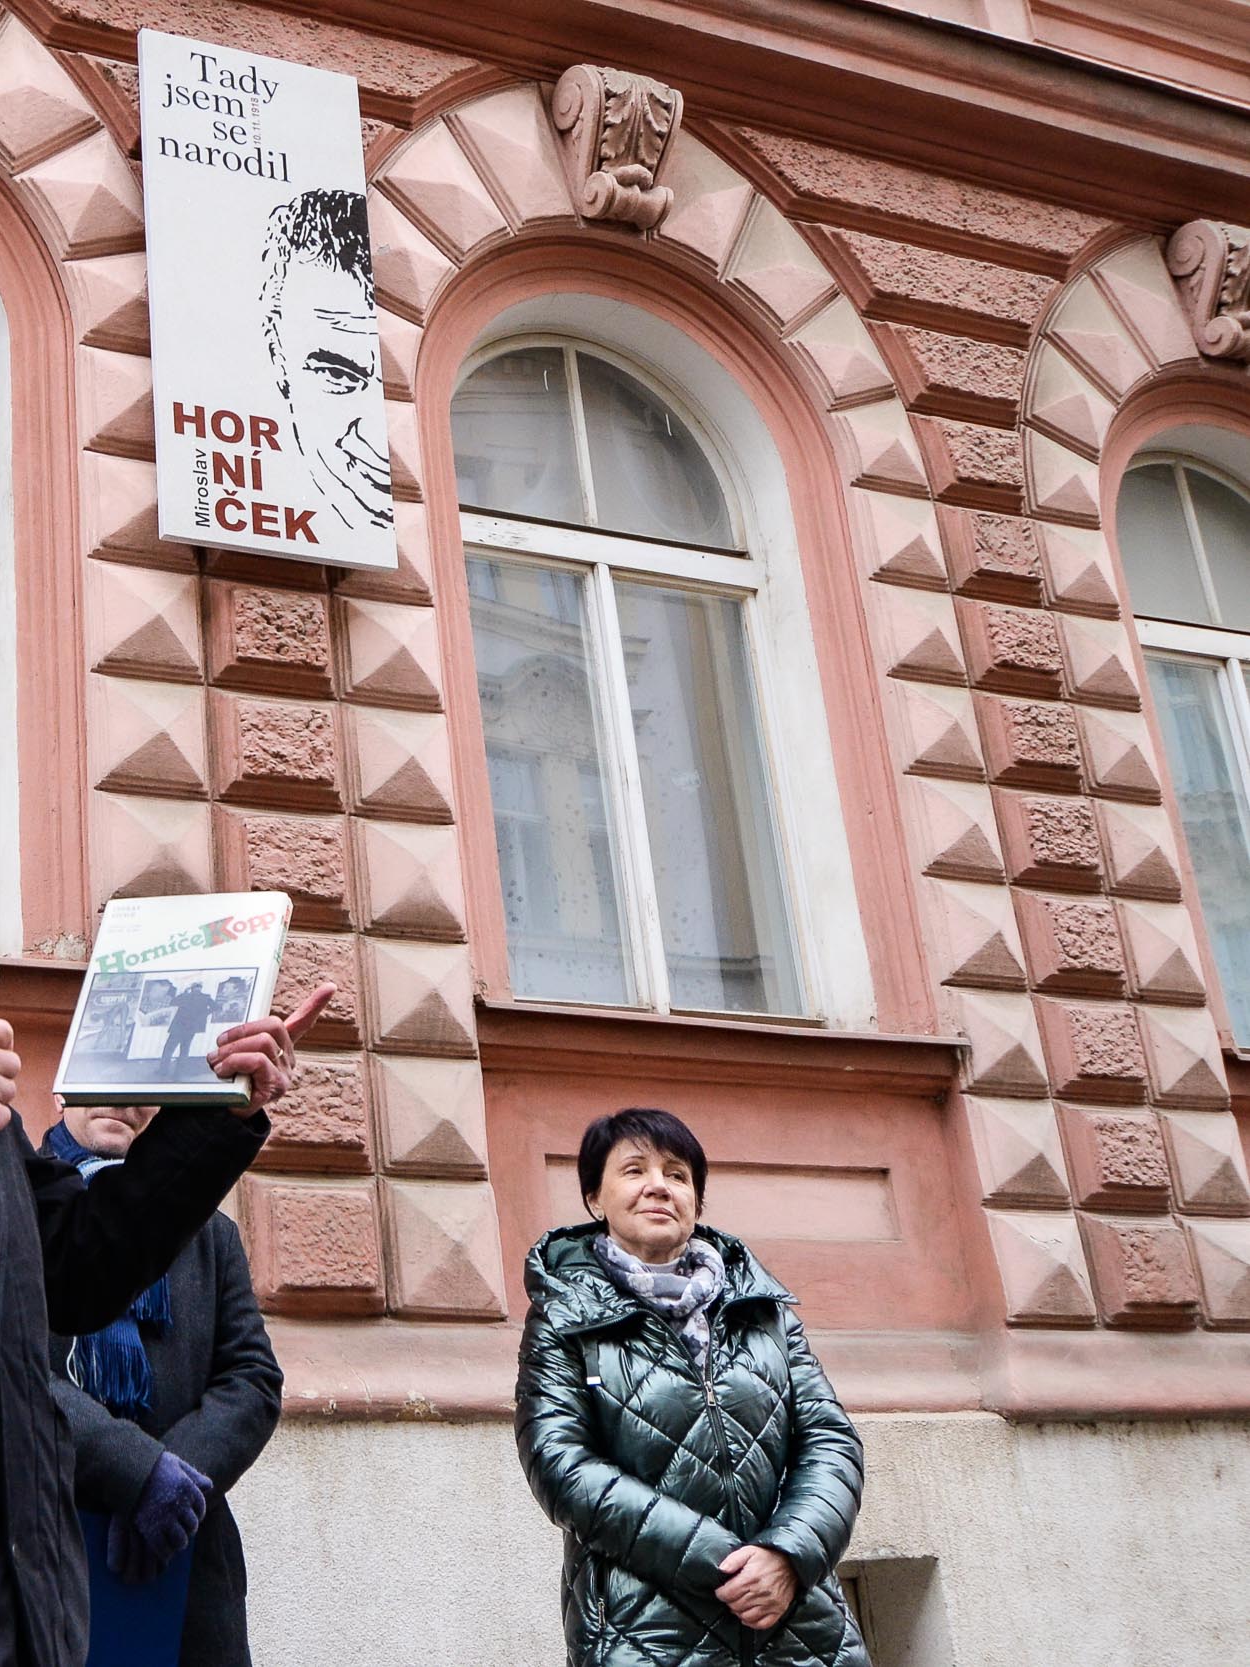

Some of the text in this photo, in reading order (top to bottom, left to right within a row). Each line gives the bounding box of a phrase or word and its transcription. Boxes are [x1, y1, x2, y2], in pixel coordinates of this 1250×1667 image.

[161, 73, 246, 118] jsem
[190, 52, 280, 104] Tady
[213, 120, 247, 145] se
[158, 136, 292, 183] narodil
[172, 401, 283, 452] HOR
[193, 448, 210, 528] Miroslav
[212, 450, 263, 491] NÍ
[214, 489, 320, 544] ČEK
